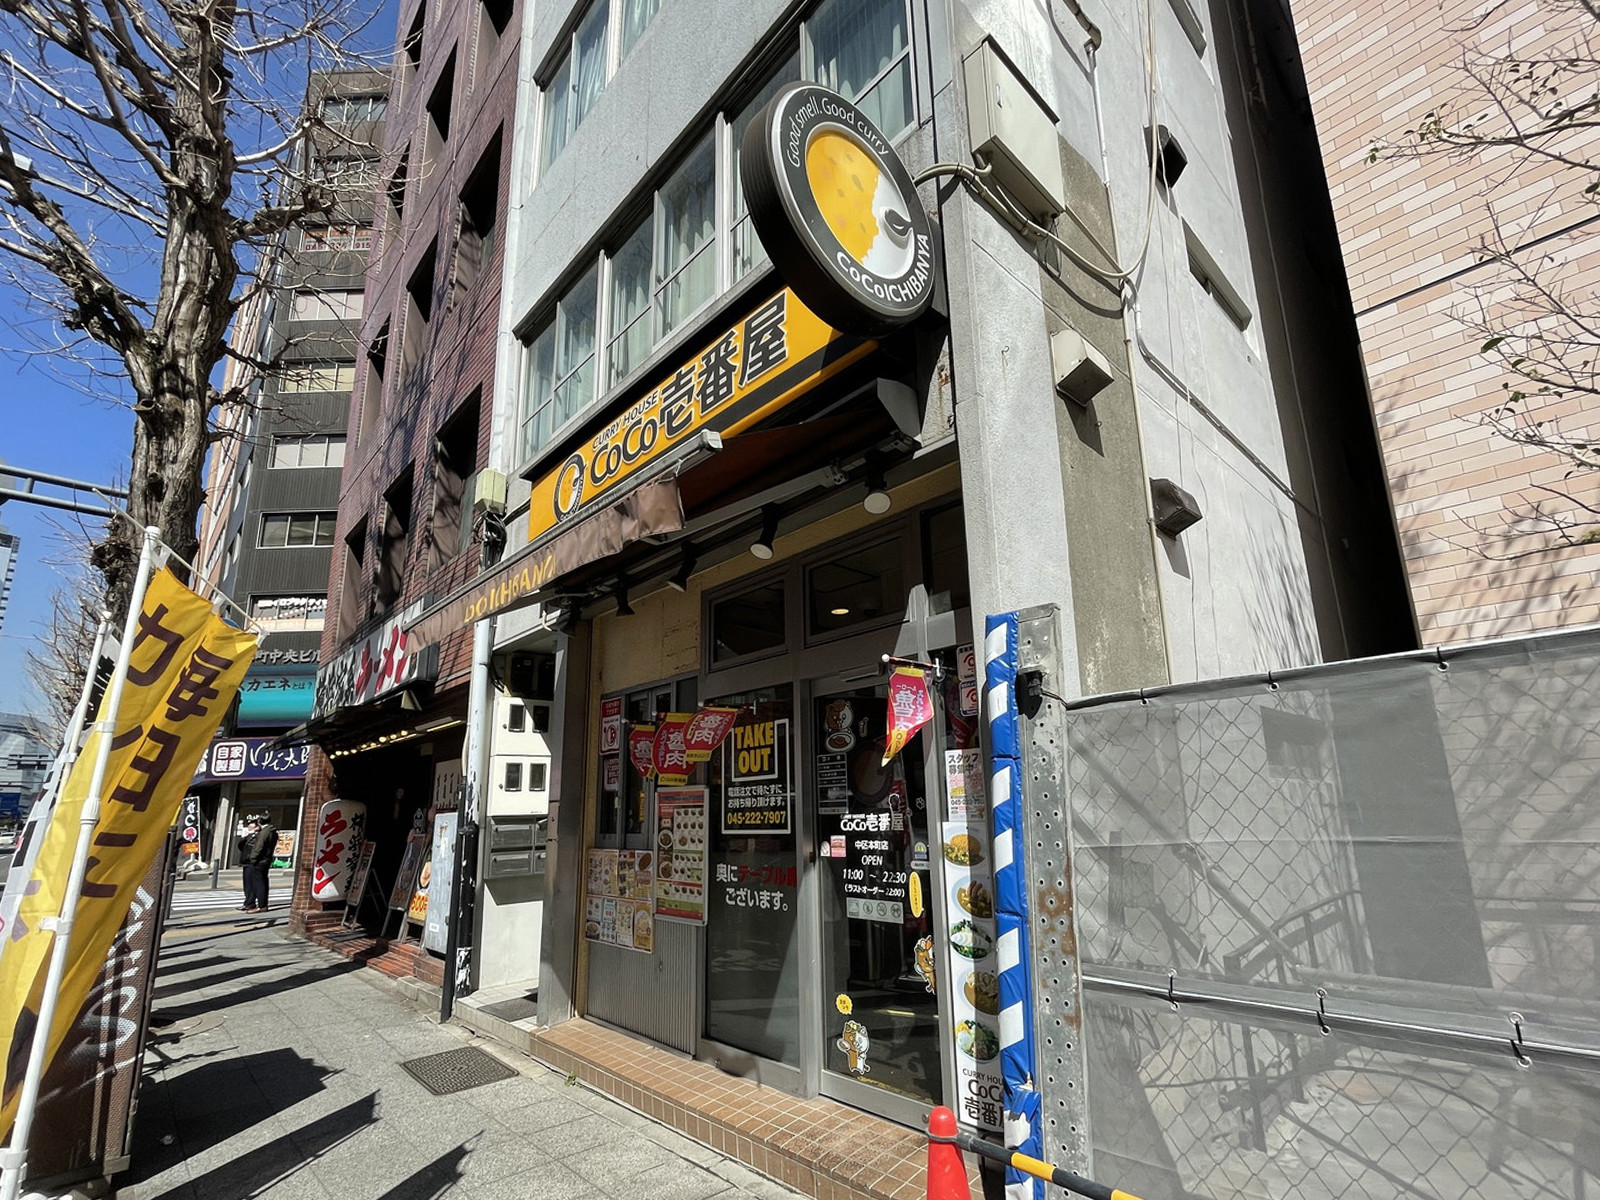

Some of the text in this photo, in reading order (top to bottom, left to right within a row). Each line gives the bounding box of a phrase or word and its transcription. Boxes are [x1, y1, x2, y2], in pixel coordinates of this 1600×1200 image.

[786, 116, 802, 168] Good
[821, 97, 855, 126] Good
[856, 120, 890, 157] curry
[589, 289, 789, 487] CoCo壱番屋
[591, 389, 660, 451] CURRY HOUSE
[734, 721, 775, 749] TAKE
[217, 746, 243, 758] 自家
[738, 747, 772, 774] OUT
[948, 752, 979, 764] スタッフ
[861, 855, 884, 867] OPEN
[842, 868, 864, 881] 11:00
[882, 871, 907, 884] 22:30
[725, 887, 789, 912] ございます。
[962, 1067, 986, 1081] CURRY
